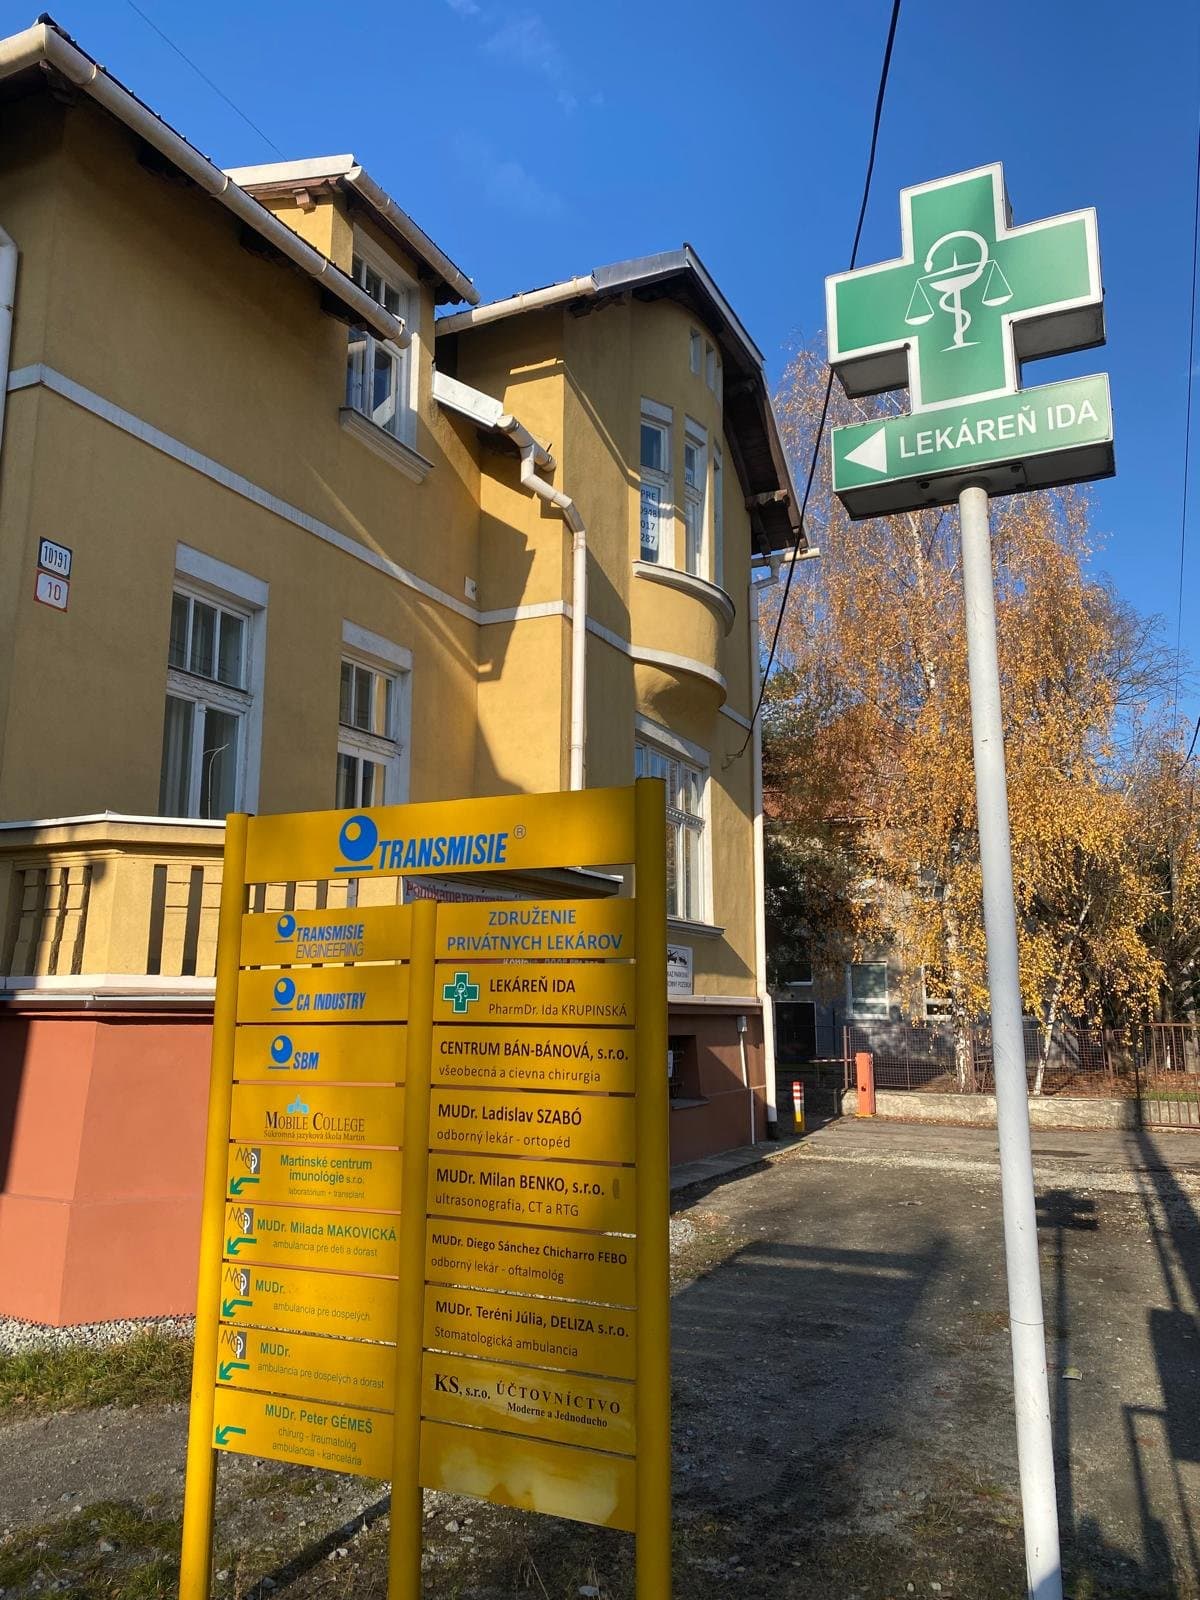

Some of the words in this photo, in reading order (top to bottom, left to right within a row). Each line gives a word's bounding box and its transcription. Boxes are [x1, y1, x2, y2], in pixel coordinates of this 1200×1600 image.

[899, 405, 1037, 459] LEKÁREŇ
[1047, 399, 1099, 431] IDA
[44, 545, 67, 570] 10191
[48, 581, 61, 601] 10
[378, 832, 508, 870] TRANSMISIE
[489, 905, 576, 926] ZDRUŽENIE
[296, 924, 365, 942] TRANSMISIE
[448, 933, 541, 951] PRIVÁTNYCH
[548, 931, 623, 950] LEKÁROV
[296, 942, 364, 958] ENGINEERING
[490, 976, 547, 992] LEKÁREŇ
[552, 980, 576, 992] IDA
[296, 994, 310, 1010] CA
[314, 992, 366, 1010] INDUSTRY
[489, 1003, 538, 1016] PharmDr.
[542, 1004, 558, 1016] Ida
[562, 1003, 627, 1017] KRUPINSKÁ
[440, 1041, 500, 1056] CENTRUM
[504, 1039, 594, 1061] BÁN-BÁNOVÁ,
[597, 1047, 629, 1060] s.r.o.
[293, 1052, 320, 1070] SBM
[439, 1065, 496, 1078] všeobecná
[500, 1068, 506, 1078] a
[508, 1067, 545, 1080] cievna
[548, 1069, 601, 1084] chirurgia
[438, 1104, 478, 1119] MUDr.
[482, 1106, 534, 1123] Ladislav
[536, 1107, 582, 1126] SZABÓ
[437, 1129, 483, 1144] odborný
[486, 1131, 514, 1144] lekár
[524, 1136, 570, 1150] ortopéd
[280, 1154, 328, 1168] Martinské
[330, 1158, 372, 1170] centrum
[289, 1168, 345, 1185] imunológie
[346, 1176, 365, 1184] s.r.o.
[436, 1168, 475, 1184] MUDr.
[480, 1172, 516, 1188] Milan
[520, 1174, 568, 1194] BENKO,
[572, 1181, 605, 1196] s.r.o.
[436, 1192, 524, 1213] ultrasonografia,
[528, 1201, 543, 1213] CT
[546, 1204, 552, 1214] a
[556, 1203, 579, 1216] RTG
[257, 1219, 286, 1232] MUDr.
[290, 1222, 324, 1236] Milada
[327, 1224, 397, 1241] MAKOVICKÁ
[272, 1240, 314, 1251] ambulancia
[316, 1244, 328, 1253] pre
[354, 1246, 378, 1256] dorast
[432, 1234, 463, 1247] MUDr.
[466, 1236, 496, 1252] Diego
[498, 1238, 540, 1256] Sánchez
[542, 1245, 595, 1262] Chicharro
[598, 1251, 627, 1266] FEBO
[474, 1260, 498, 1273] lekár
[508, 1265, 564, 1284] oftalmológ
[256, 1280, 286, 1294] MUDr.
[273, 1302, 315, 1315] ambulancia
[316, 1308, 329, 1317] pre
[332, 1307, 370, 1322] dospelých
[436, 1300, 472, 1317] MUDr.
[476, 1305, 512, 1322] Teréni
[516, 1310, 546, 1329] Júlia,
[551, 1315, 594, 1334] DELIZA
[598, 1324, 629, 1338] s.r.o.
[260, 1342, 290, 1358] MUDr.
[435, 1326, 512, 1348] Stomatologická
[516, 1338, 578, 1356] ambulancia
[257, 1362, 298, 1376] ambulancia
[300, 1370, 312, 1379] pre
[314, 1370, 350, 1384] dospelých
[360, 1376, 384, 1388] dorast
[434, 1373, 463, 1396] KS,
[466, 1387, 491, 1400] s.r.o.
[496, 1380, 621, 1414] ÚČTOVNÍCTVO
[265, 1404, 296, 1421] MUDr.
[300, 1410, 328, 1426] Peter
[331, 1414, 373, 1434] GÉMEŠ
[507, 1402, 545, 1417] Moderne
[548, 1410, 552, 1418] a
[554, 1412, 608, 1428] Jednoducho
[272, 1442, 315, 1457] ambulancia
[278, 1427, 304, 1441] chirurg
[311, 1432, 357, 1452] traumatológ
